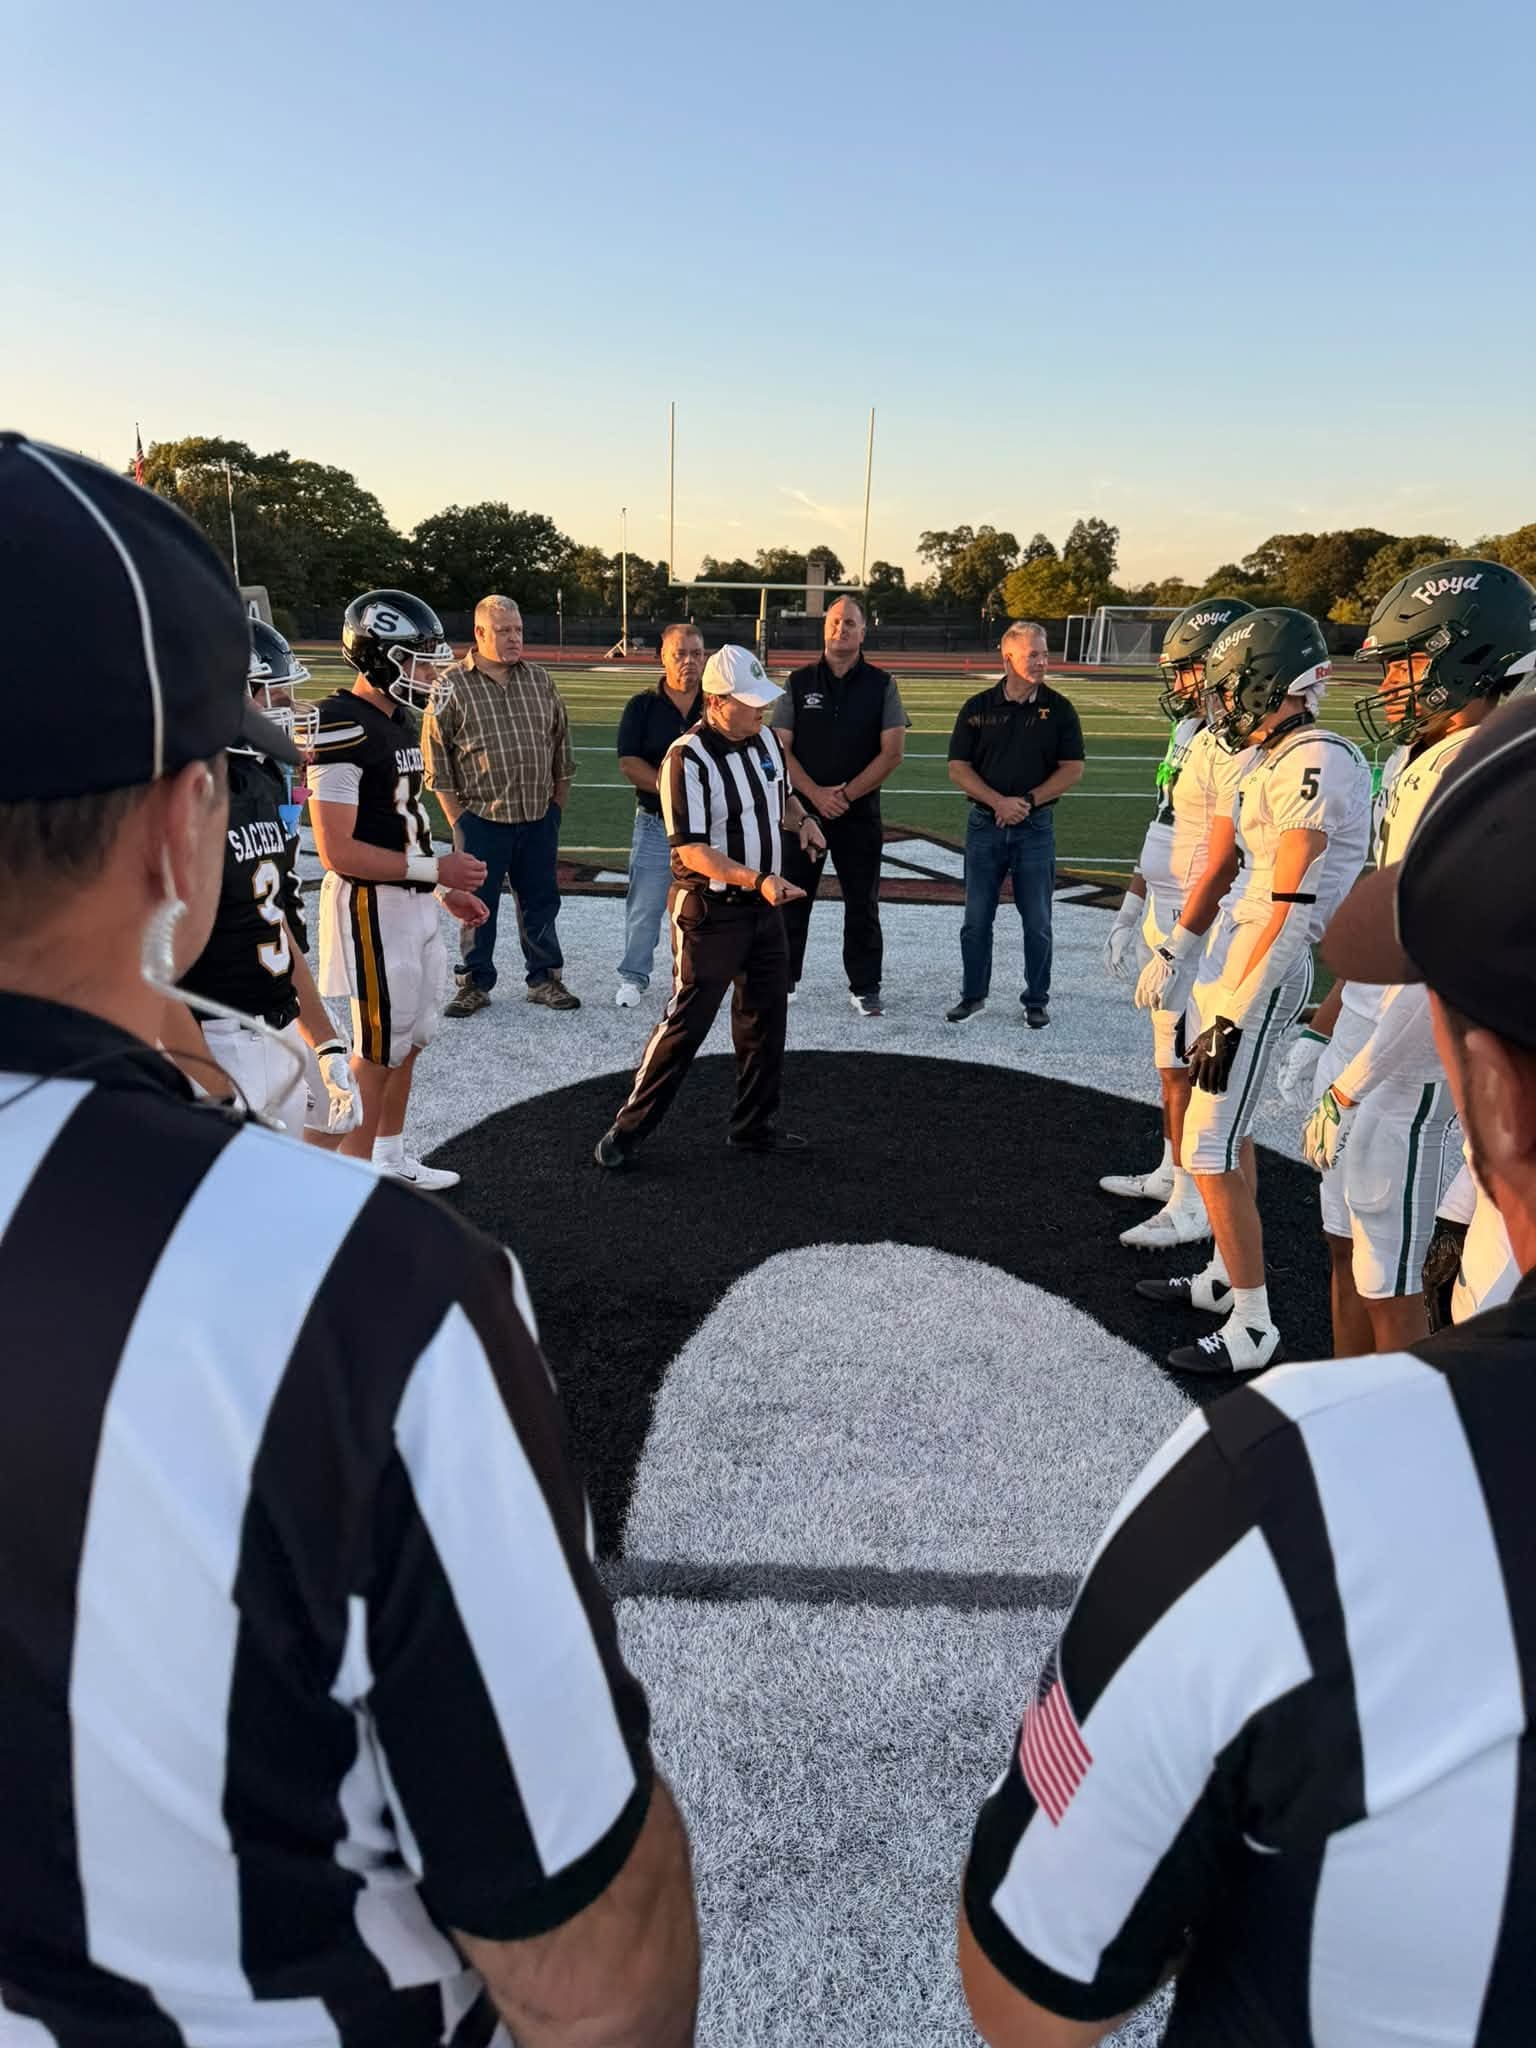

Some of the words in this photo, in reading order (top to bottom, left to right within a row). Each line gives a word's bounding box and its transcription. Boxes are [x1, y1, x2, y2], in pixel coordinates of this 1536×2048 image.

[1411, 573, 1483, 605] Floyd
[373, 612, 400, 633] S
[1187, 610, 1232, 632] Floyd
[1212, 623, 1256, 661] Floyd
[1300, 767, 1321, 801] 5
